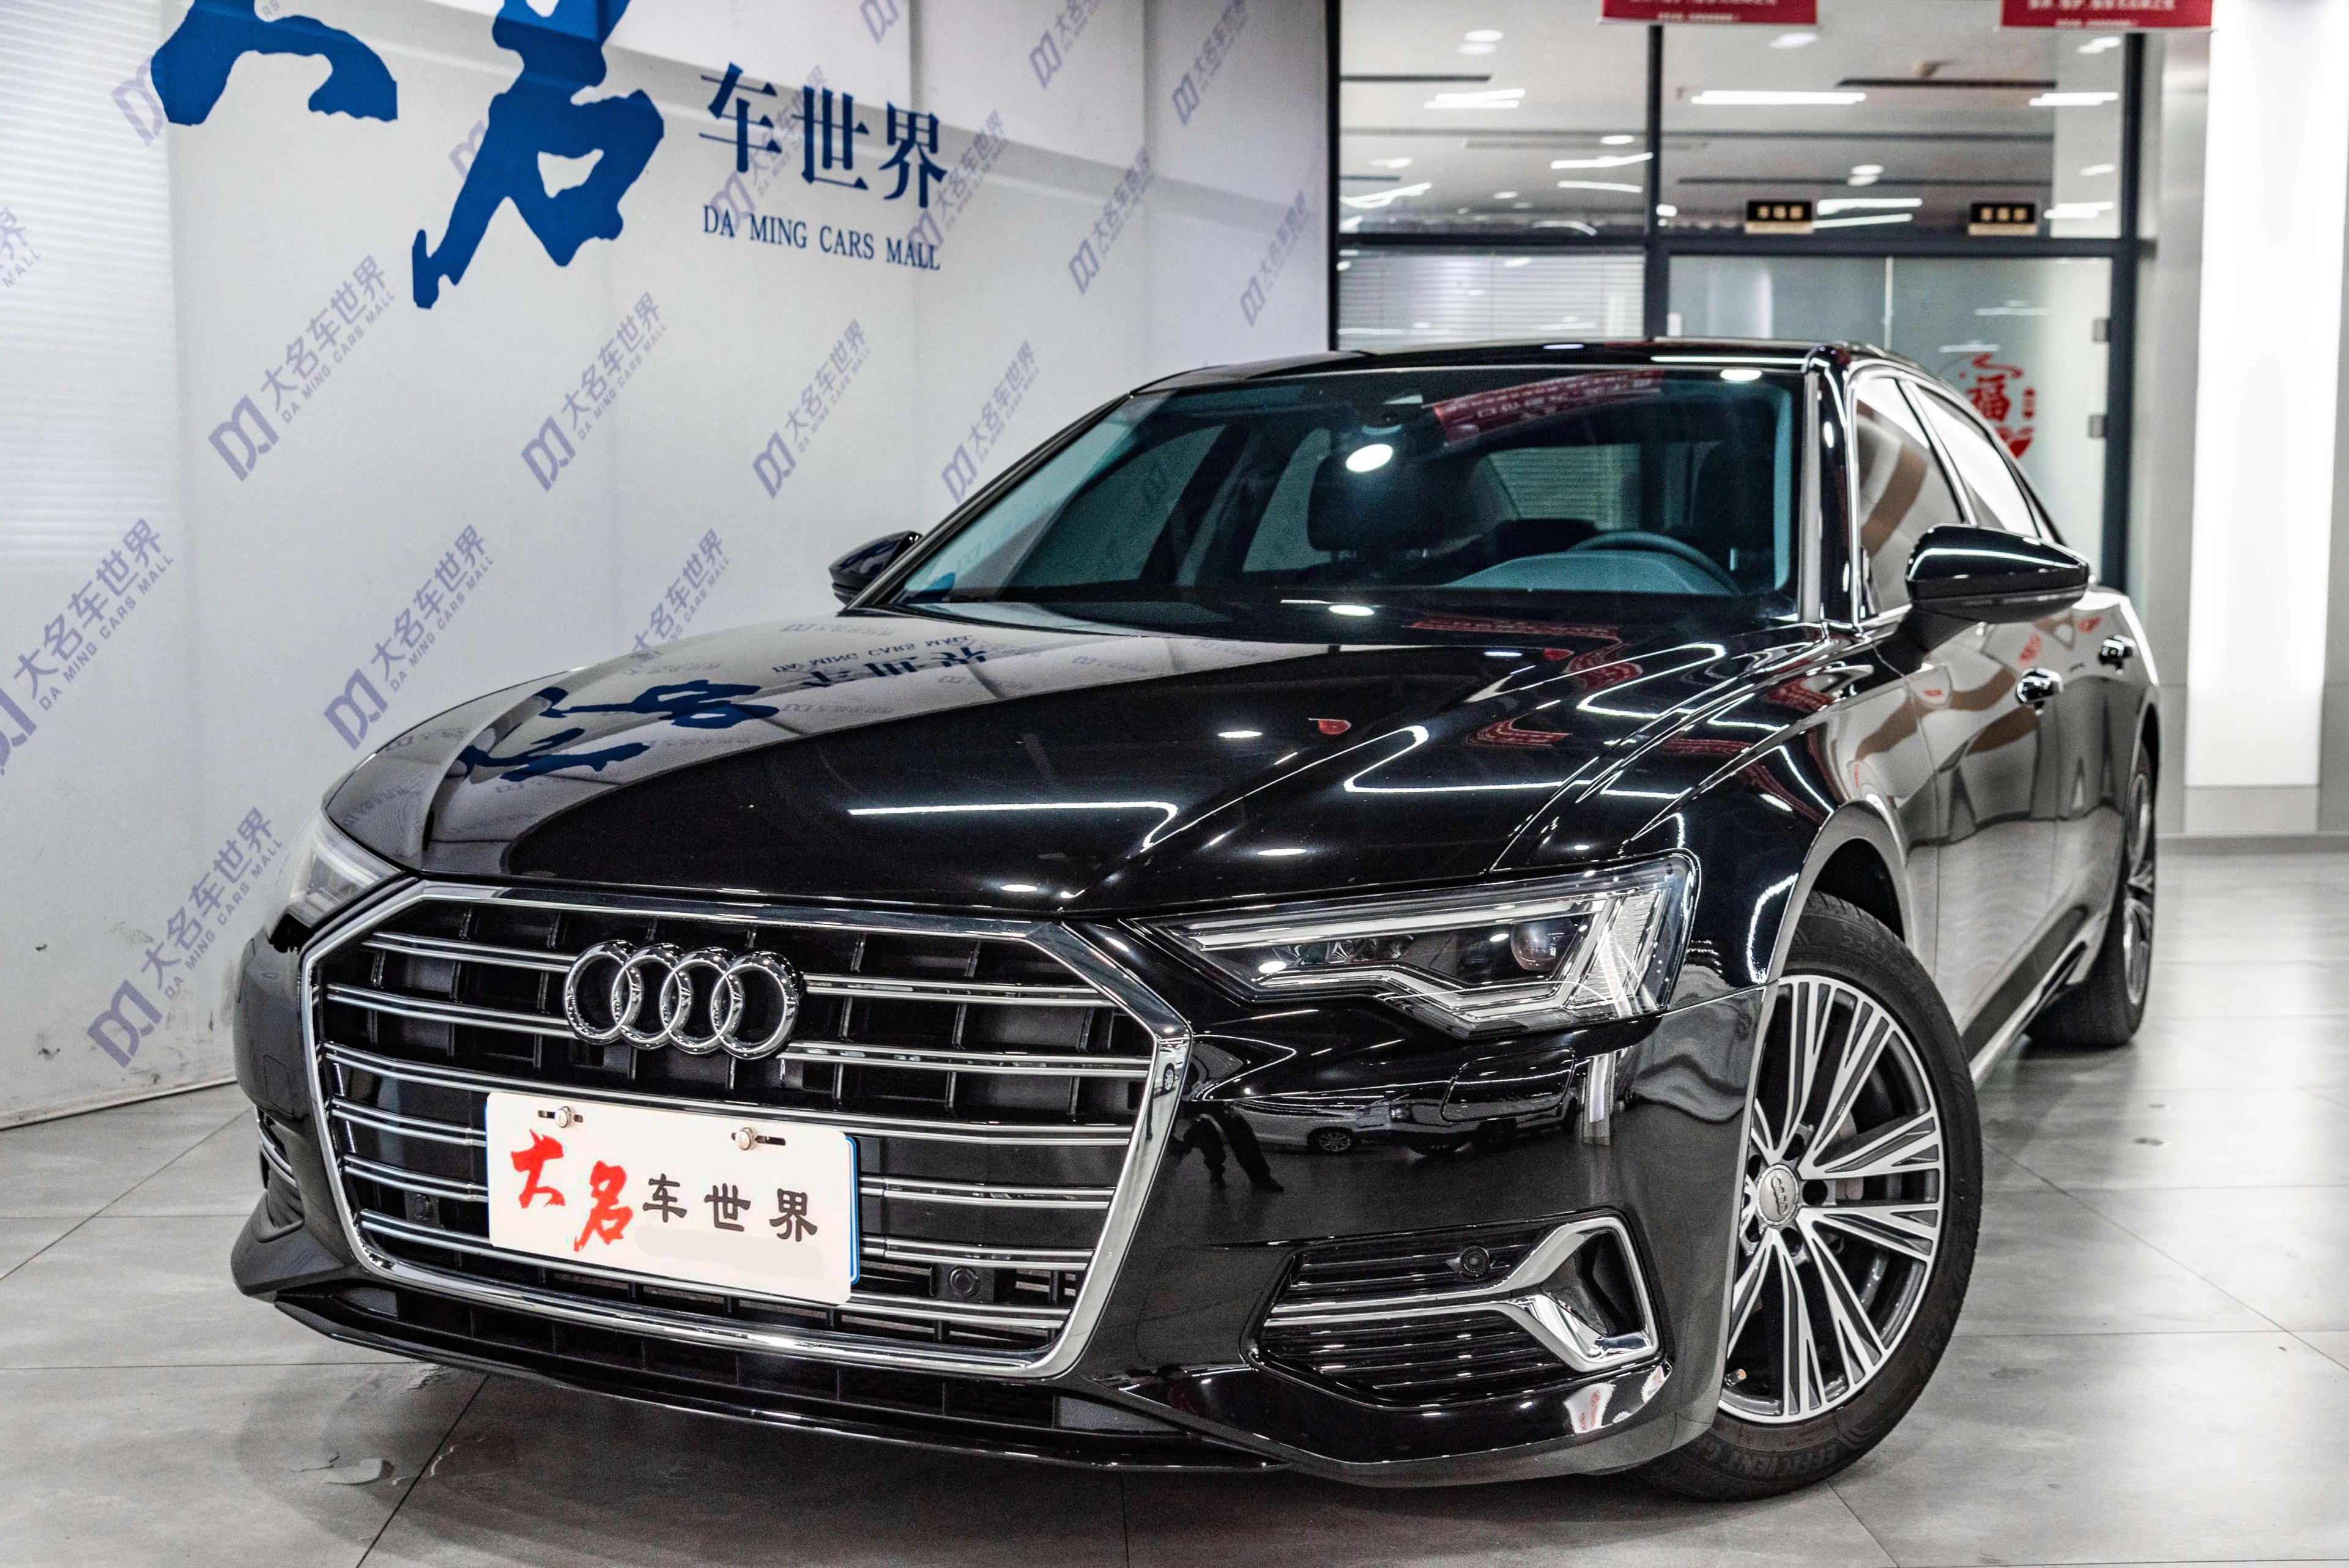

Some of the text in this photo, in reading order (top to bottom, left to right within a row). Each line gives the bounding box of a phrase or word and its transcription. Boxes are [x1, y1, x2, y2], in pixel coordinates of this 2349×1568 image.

[699, 62, 948, 208] 车世界
[2, 249, 42, 288] MALL
[703, 205, 940, 270] DA MING CARS MALL
[261, 255, 384, 413] 大名车世界
[281, 291, 395, 424] DA MING CARS MALL
[562, 291, 660, 430] 大名车世界
[785, 319, 866, 444] 大名车世界
[968, 340, 1035, 454] 大名车世界
[13, 518, 161, 700] 大名车世界
[39, 554, 173, 711] DA MING CARS MALL
[371, 524, 484, 682] 大名车世界
[390, 556, 494, 692] DA MING CARS MALL
[141, 806, 272, 990] 大名车世界
[164, 839, 283, 999] DA MING CARS MALL
